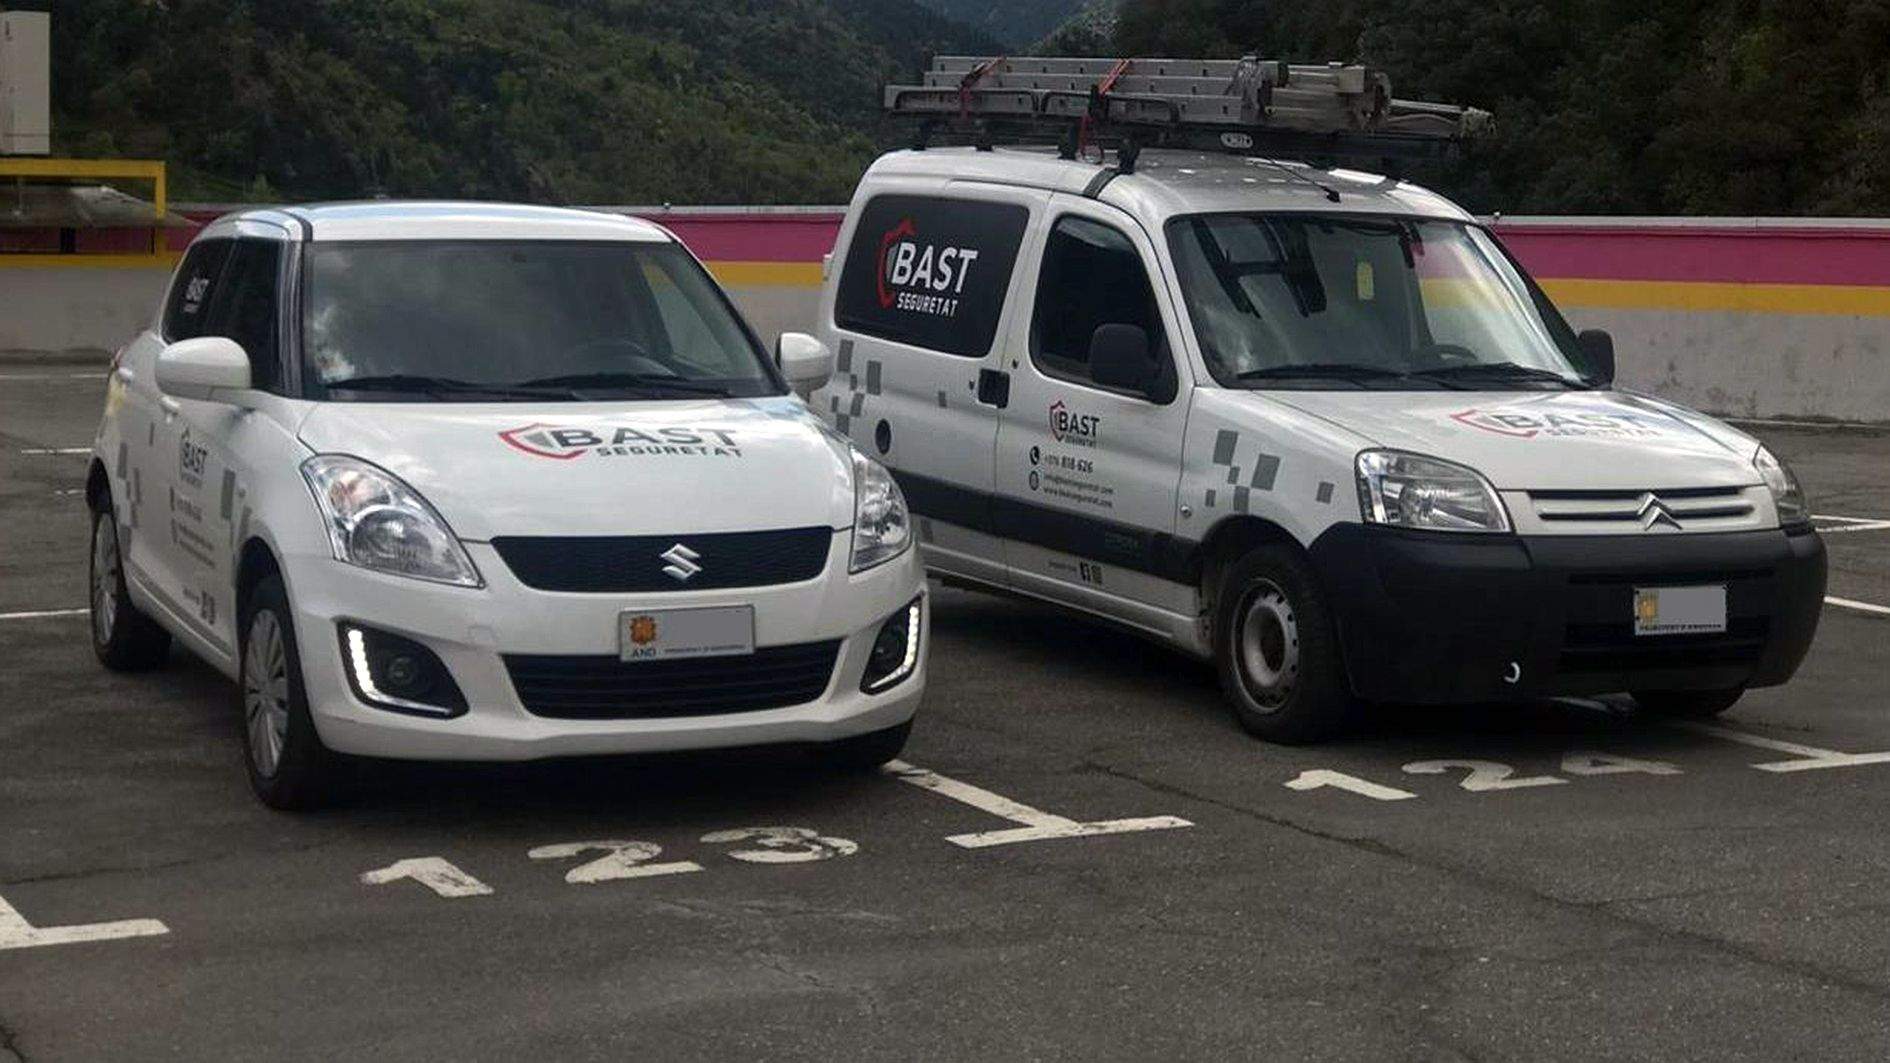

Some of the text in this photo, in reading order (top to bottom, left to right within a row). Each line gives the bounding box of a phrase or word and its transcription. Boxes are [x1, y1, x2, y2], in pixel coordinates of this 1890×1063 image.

[891, 242, 978, 293] BAST
[897, 292, 958, 317] SEGURETAT
[1059, 411, 1100, 437] BAST
[554, 427, 739, 448] BAST
[183, 441, 207, 475] BAST
[597, 448, 742, 458] SEGURETAT
